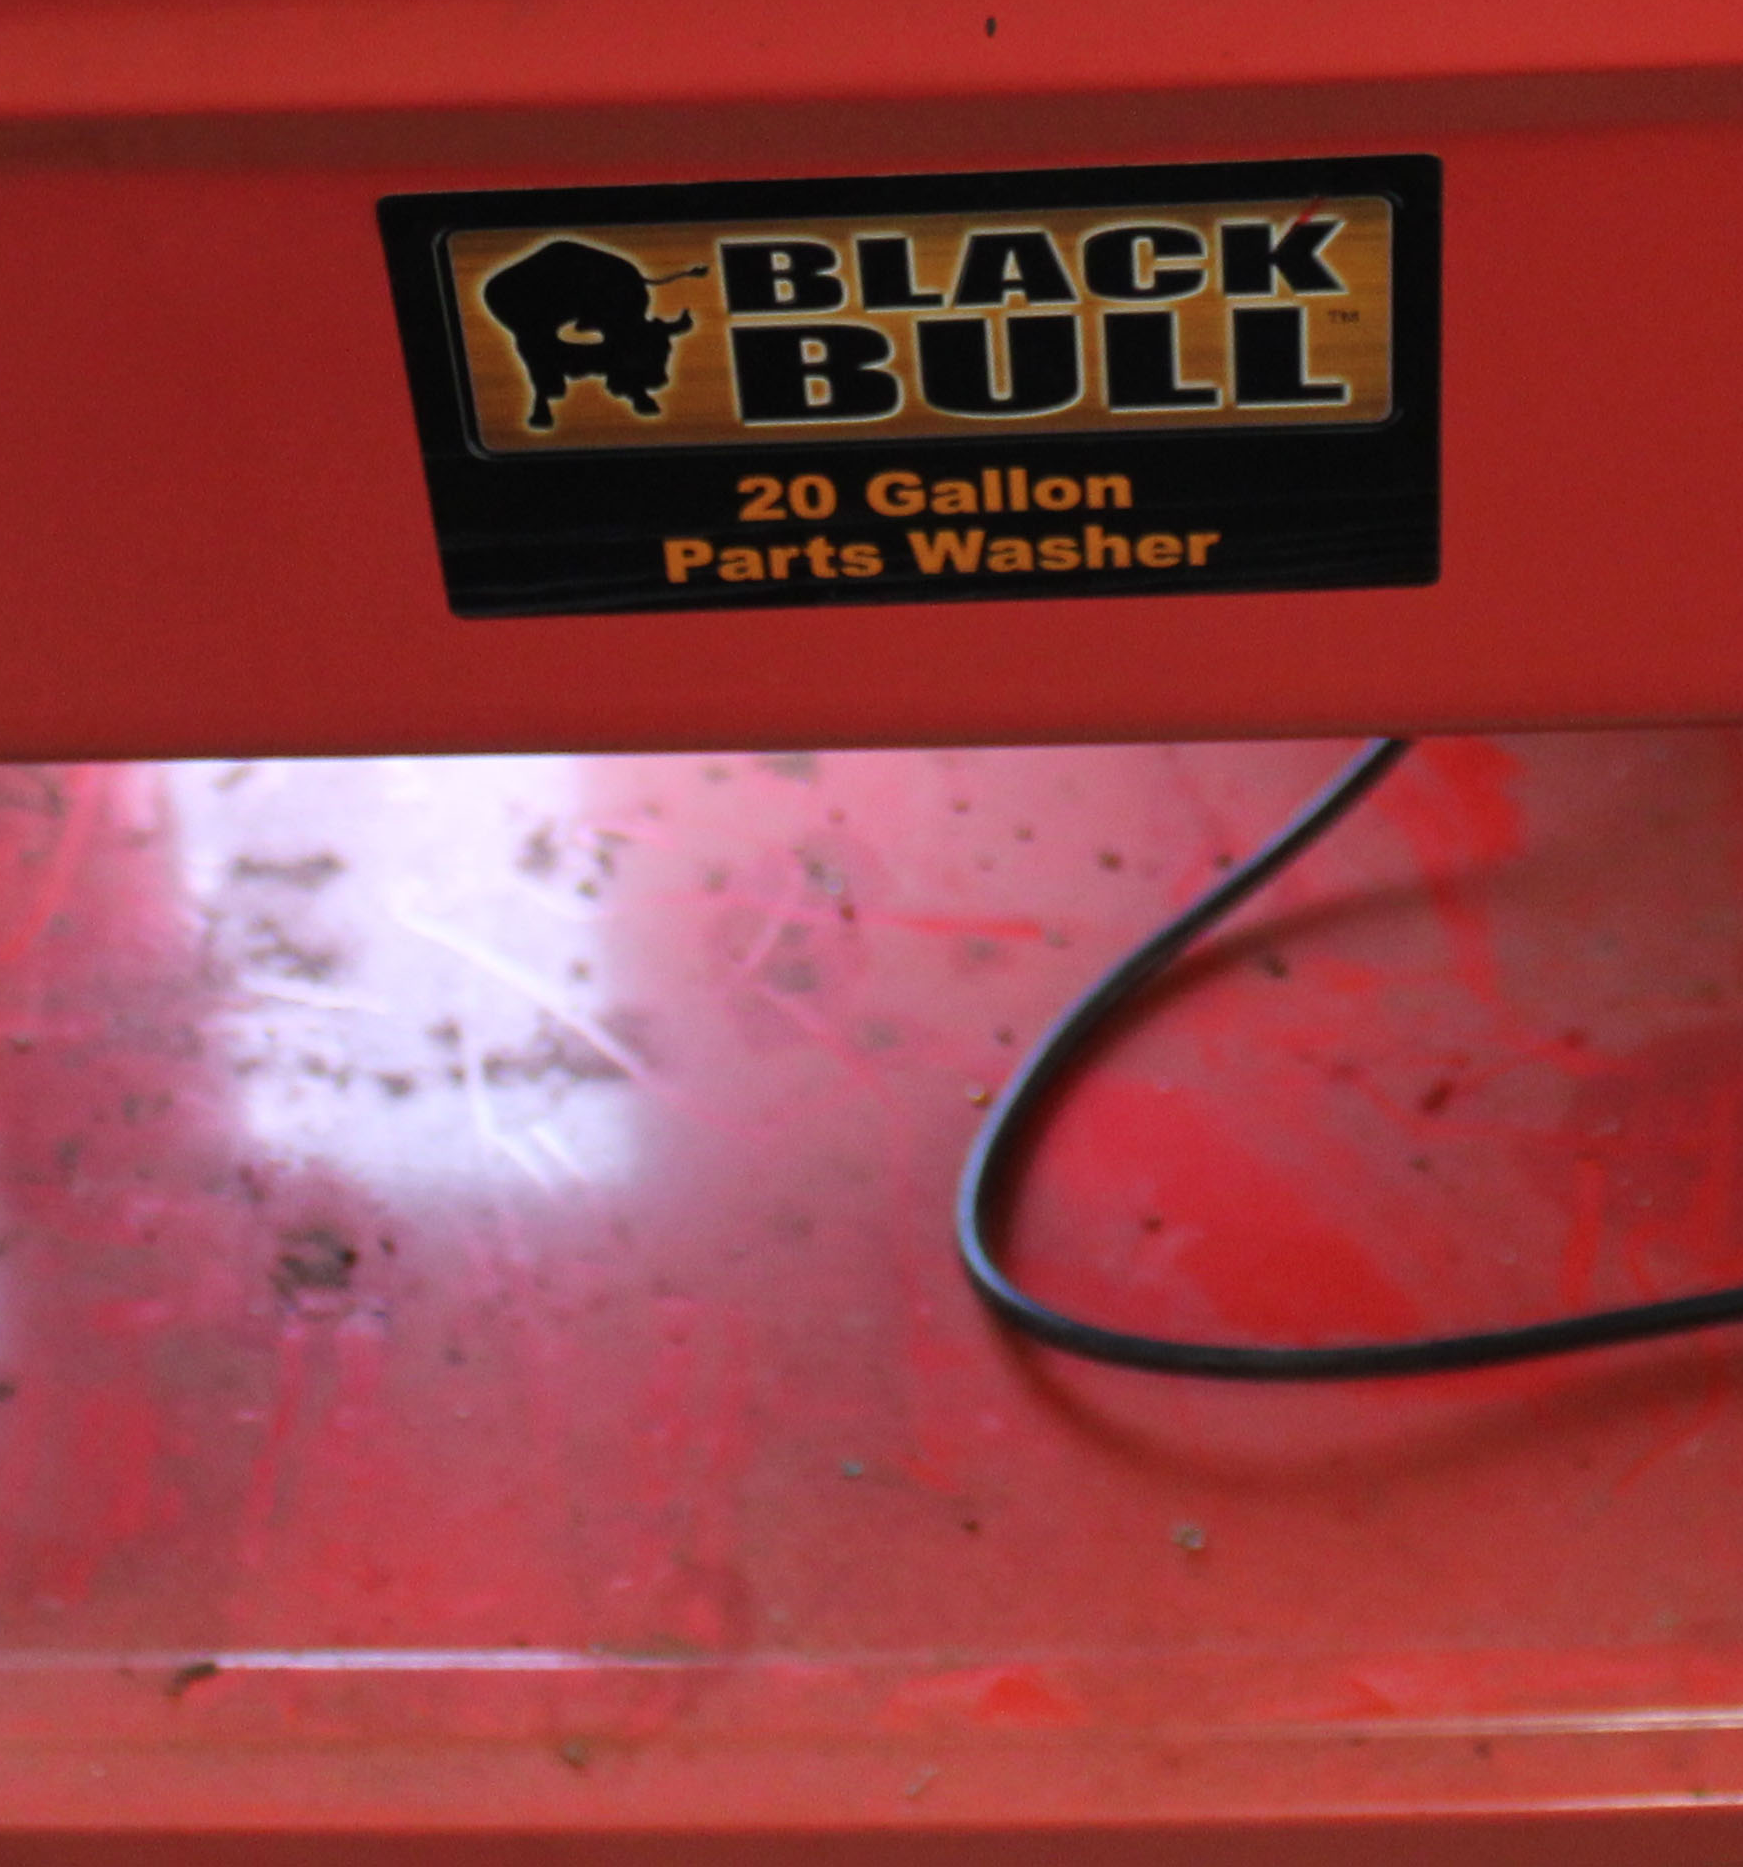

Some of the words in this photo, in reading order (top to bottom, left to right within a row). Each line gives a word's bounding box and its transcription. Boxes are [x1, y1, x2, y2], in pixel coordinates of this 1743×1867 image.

[718, 215, 1348, 314] BLACK
[729, 305, 1351, 427] BULL
[736, 474, 837, 520] 20
[866, 468, 1133, 518] Gallon
[663, 535, 883, 583] Parts
[910, 526, 1220, 577] Washer
